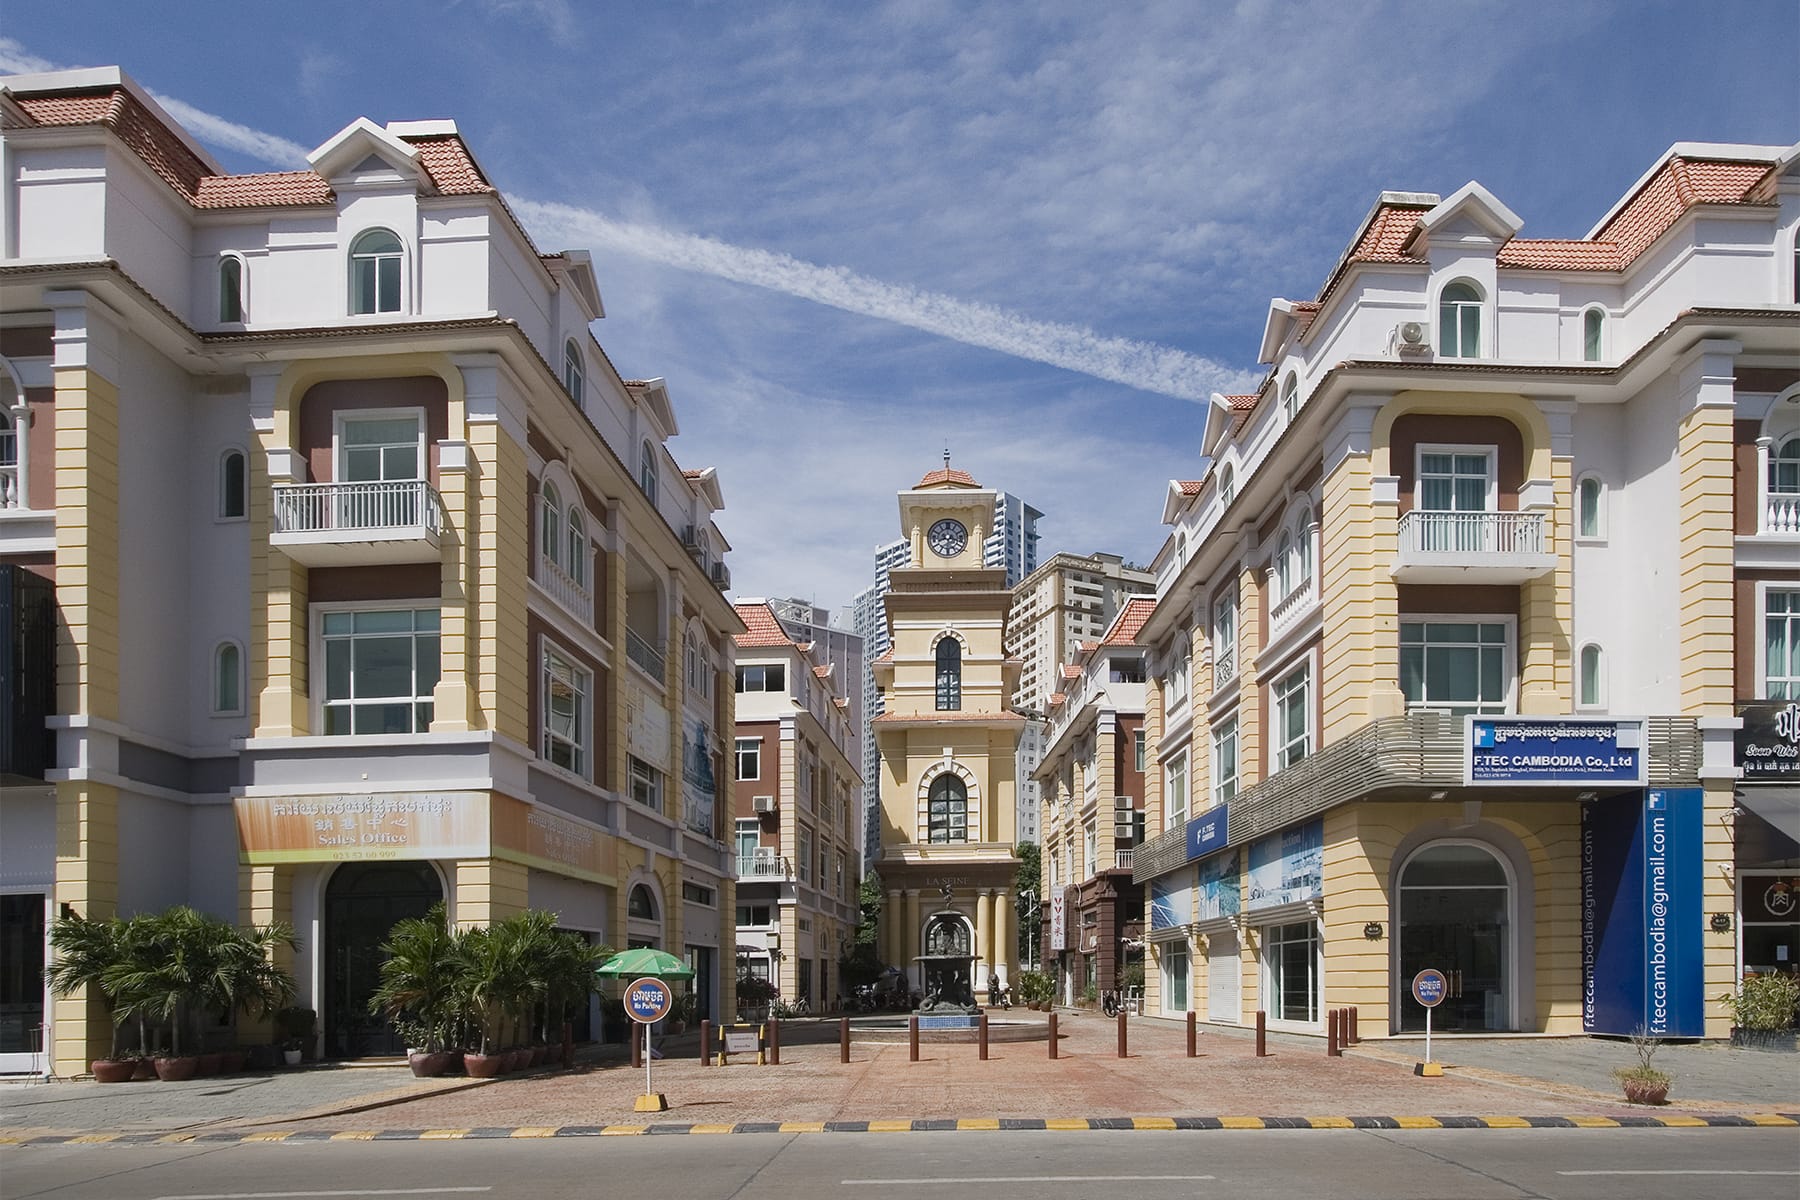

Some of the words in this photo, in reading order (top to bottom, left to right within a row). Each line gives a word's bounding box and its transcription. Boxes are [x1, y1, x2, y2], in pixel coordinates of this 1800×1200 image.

[1474, 756, 1509, 766] F.TEC
[1512, 756, 1583, 766] CAMBODIA
[1610, 756, 1633, 766] Ltd
[319, 834, 356, 845] Sales
[361, 832, 408, 844] Office
[926, 877, 940, 885] LA
[942, 876, 969, 885] SEINE
[1583, 830, 1595, 1027] f.teccambodia@gmail.com
[1650, 817, 1669, 1034] f.teccambodia@gmail.com
[642, 1001, 662, 1010] Parking
